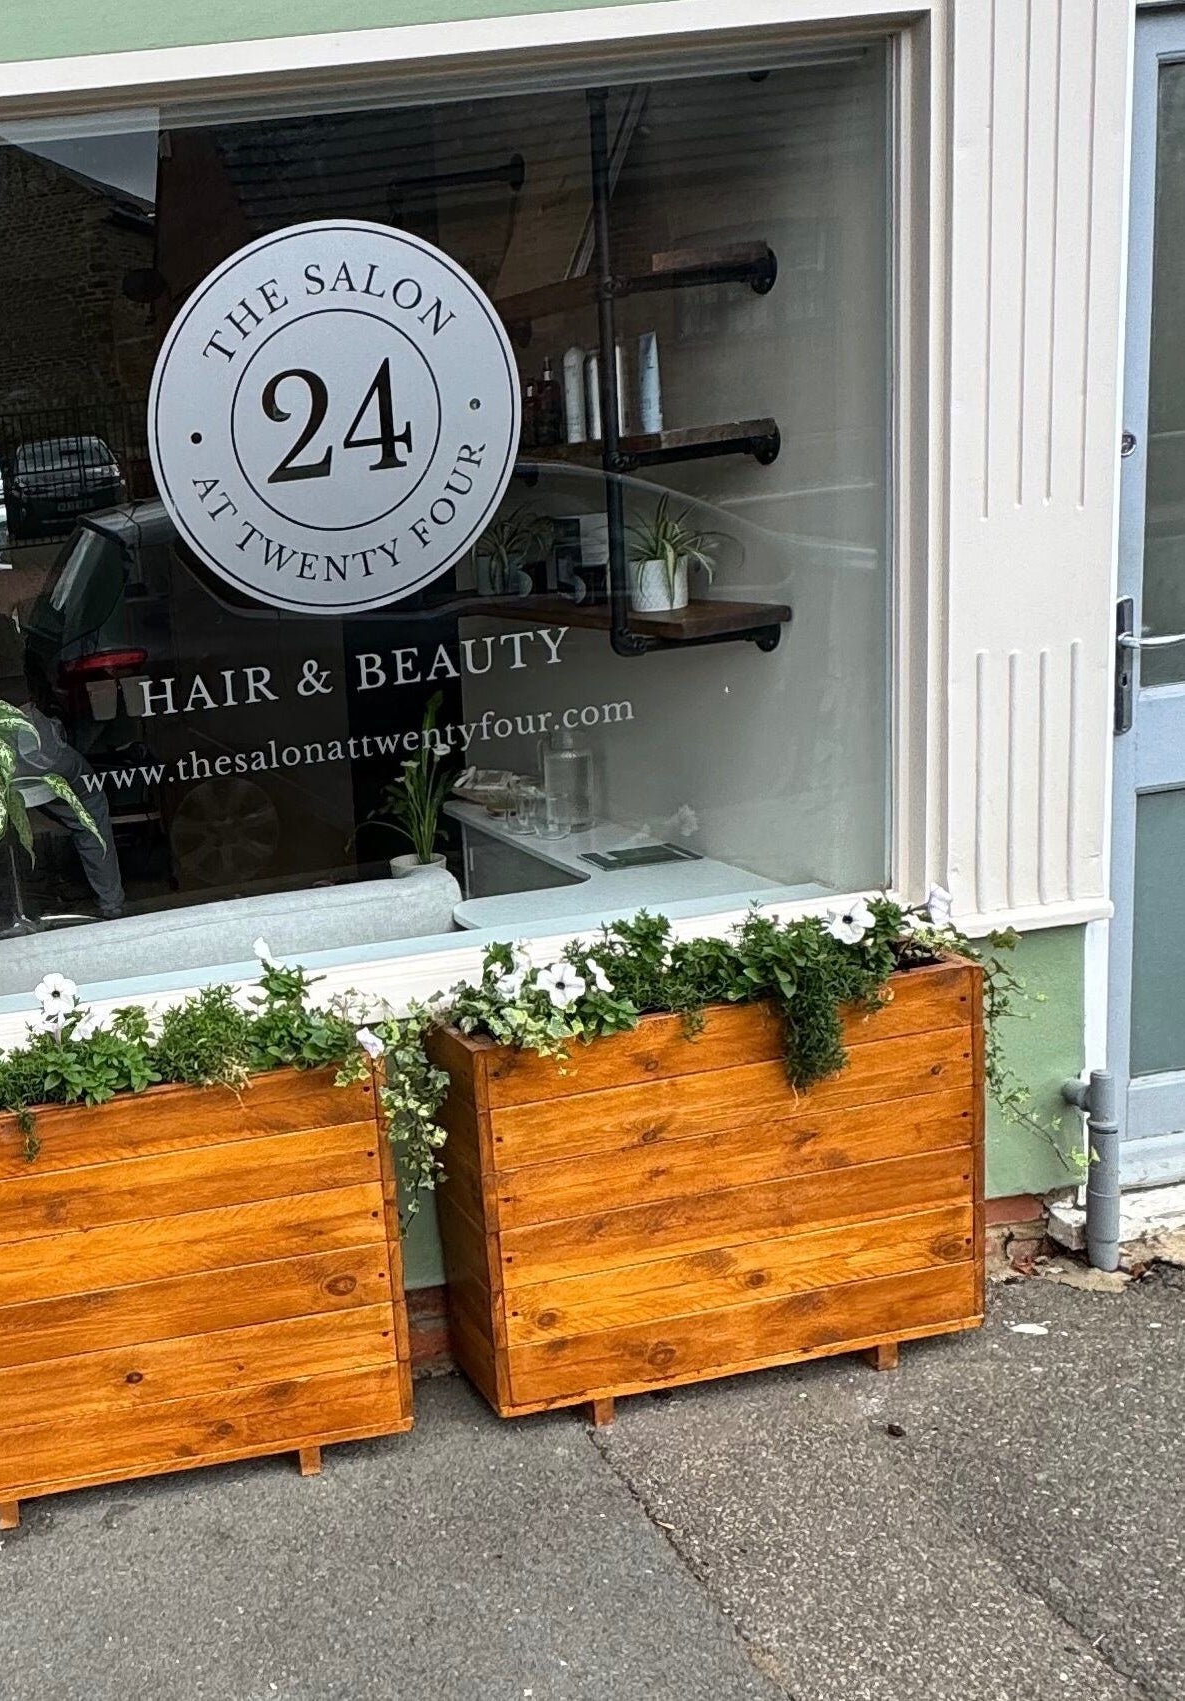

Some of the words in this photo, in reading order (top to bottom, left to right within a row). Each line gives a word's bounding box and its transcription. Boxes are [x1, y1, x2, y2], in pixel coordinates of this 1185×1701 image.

[202, 278, 289, 364] THE
[303, 261, 456, 337] SALON
[261, 357, 413, 484] 24
[192, 476, 238, 522] AT
[235, 521, 402, 582] TWENTY
[408, 443, 487, 548] FOUR
[139, 666, 279, 718] HAIR
[297, 659, 333, 697] &
[356, 626, 571, 692] BEAUTY
[80, 700, 636, 794] www.thesalonattwentyfour.com
